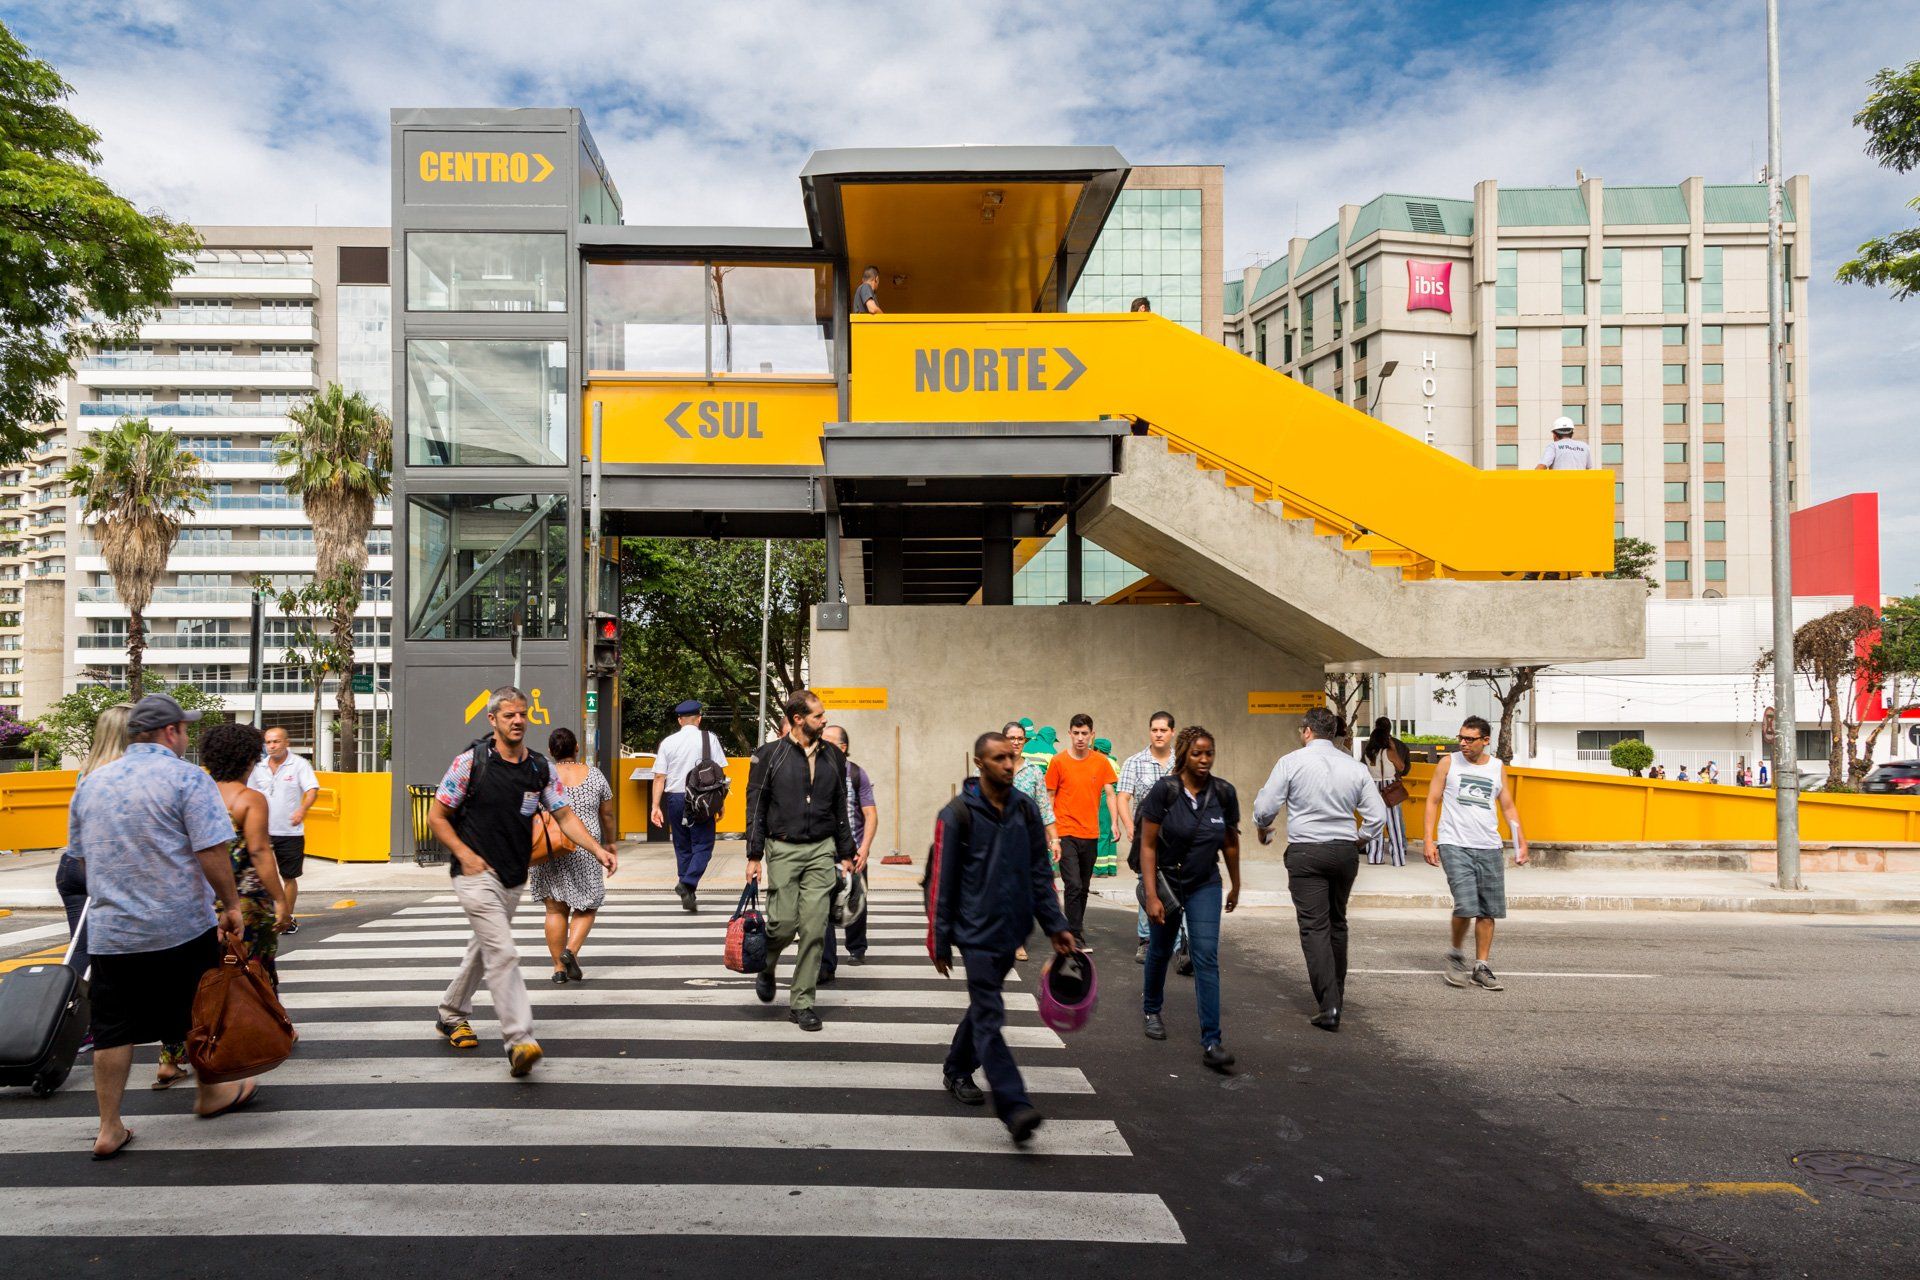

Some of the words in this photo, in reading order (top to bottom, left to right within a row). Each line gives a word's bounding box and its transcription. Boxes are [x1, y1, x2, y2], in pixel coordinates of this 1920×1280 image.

[420, 151, 529, 183] CENTRO
[1415, 276, 1445, 295] ibis
[916, 348, 1047, 393] NORTE
[1422, 351, 1436, 447] HOTE
[699, 401, 762, 439] SUL
